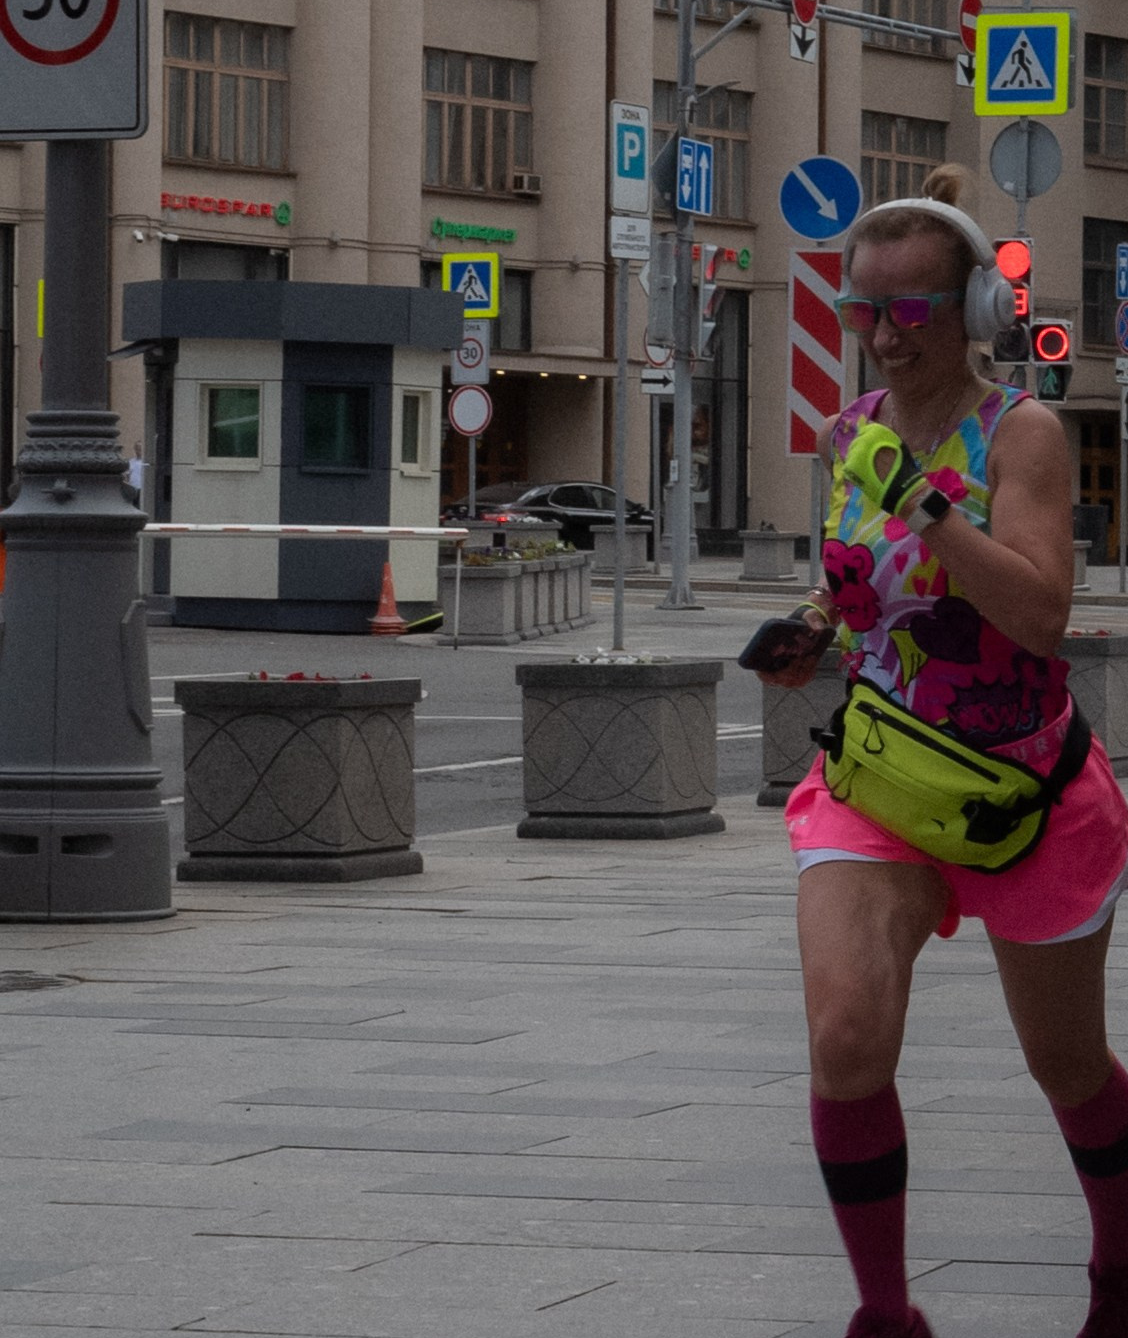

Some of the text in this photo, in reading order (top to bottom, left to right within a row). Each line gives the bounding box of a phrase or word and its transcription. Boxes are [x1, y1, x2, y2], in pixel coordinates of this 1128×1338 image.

[620, 108, 641, 122] ЗОНА
[1013, 288, 1028, 315] 3
[462, 347, 478, 360] 30
